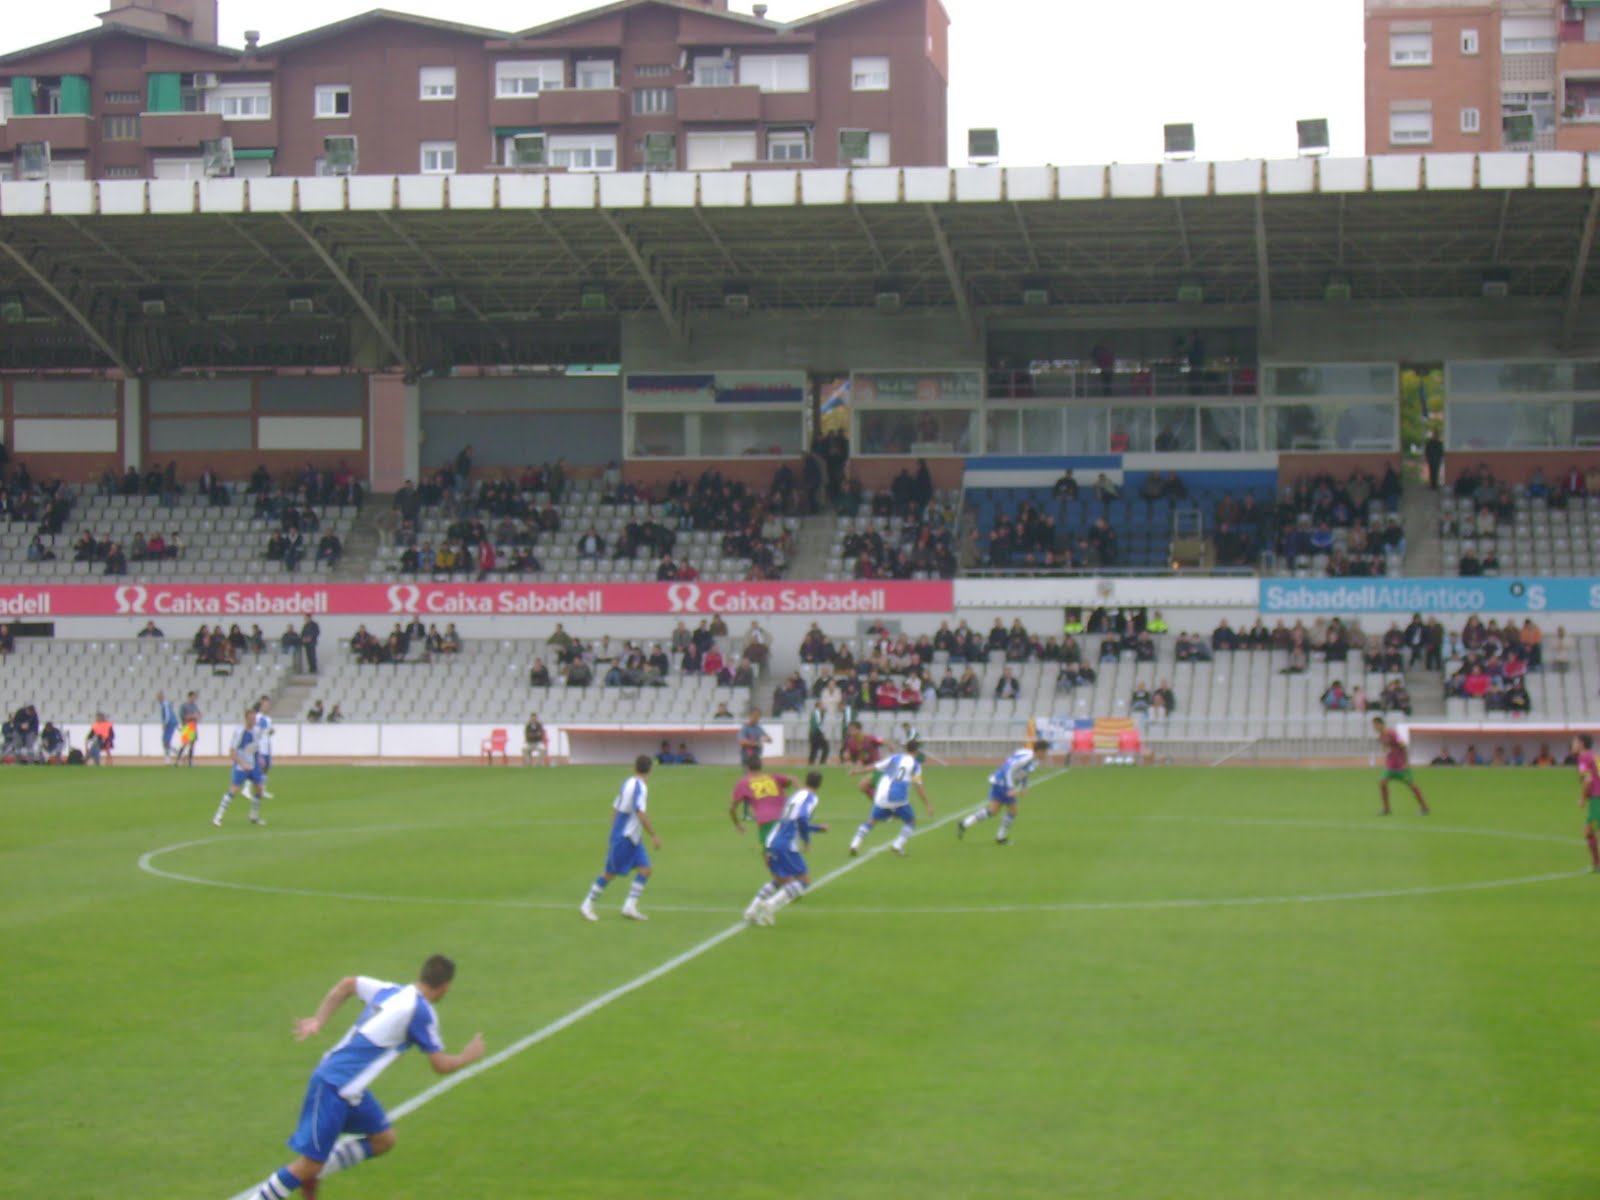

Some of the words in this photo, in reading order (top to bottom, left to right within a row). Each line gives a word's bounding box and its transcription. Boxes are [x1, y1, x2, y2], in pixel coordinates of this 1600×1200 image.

[154, 592, 220, 614] Caixa
[224, 591, 327, 614] Sabadell
[426, 591, 492, 613] Caixa
[498, 591, 602, 613] Sabadell
[707, 590, 774, 612] Caixa
[780, 589, 885, 611] Sabadell
[1266, 585, 1485, 609] SabadellAtlántico
